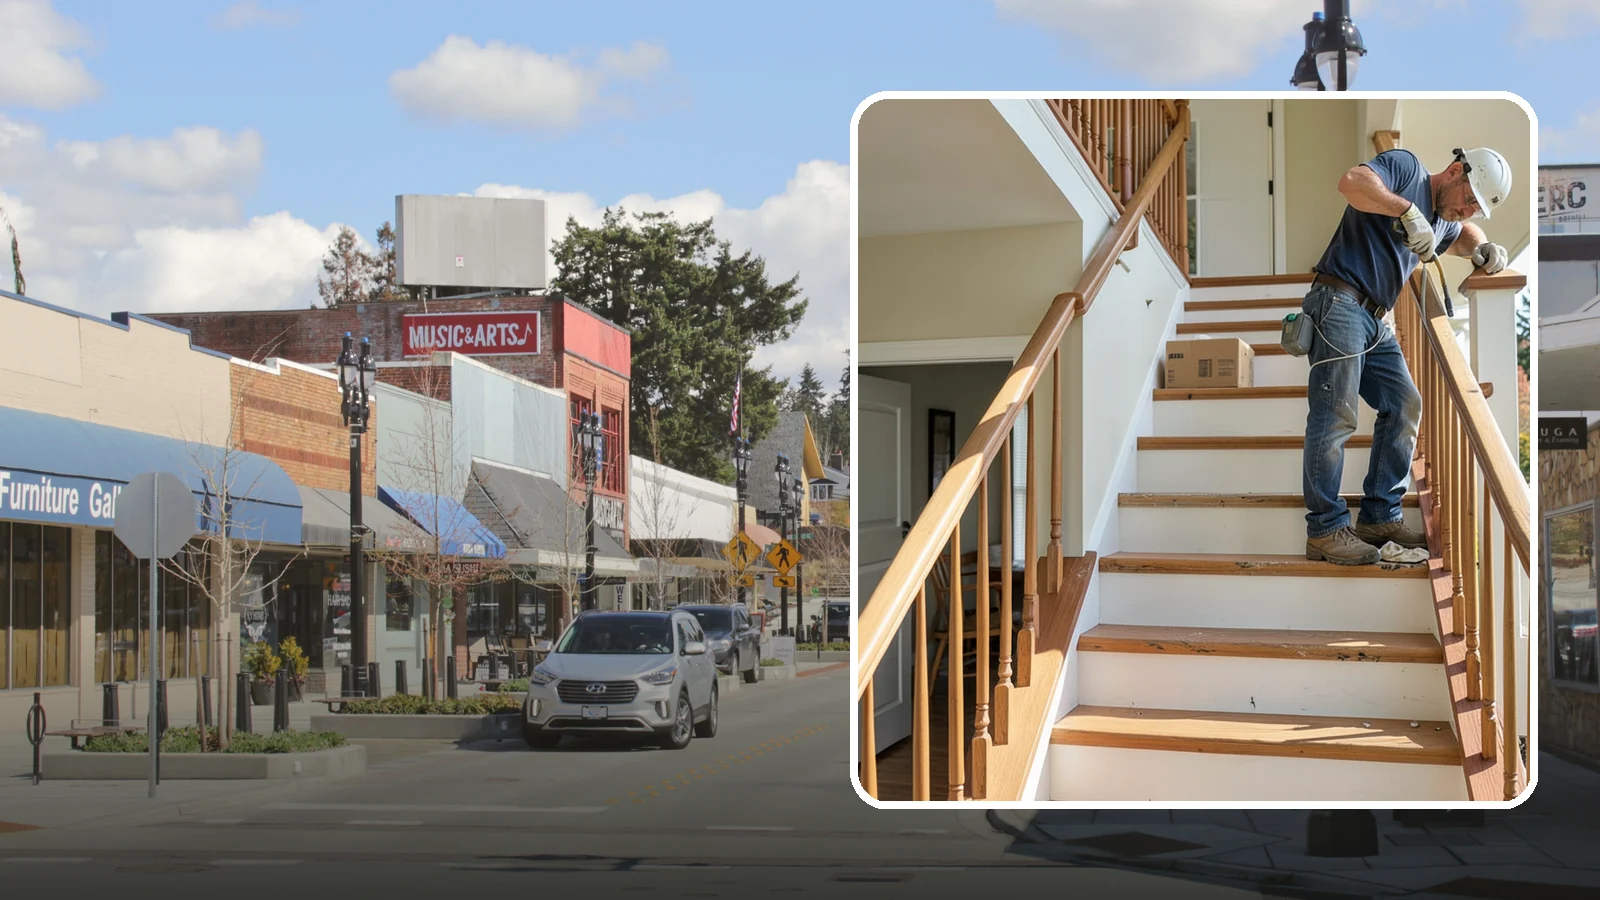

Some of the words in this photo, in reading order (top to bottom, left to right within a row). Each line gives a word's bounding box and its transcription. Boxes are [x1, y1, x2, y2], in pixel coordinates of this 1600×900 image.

[408, 322, 521, 349] MUSIC&ARTS
[0, 471, 79, 515] Furniture
[89, 482, 122, 519] Gal
